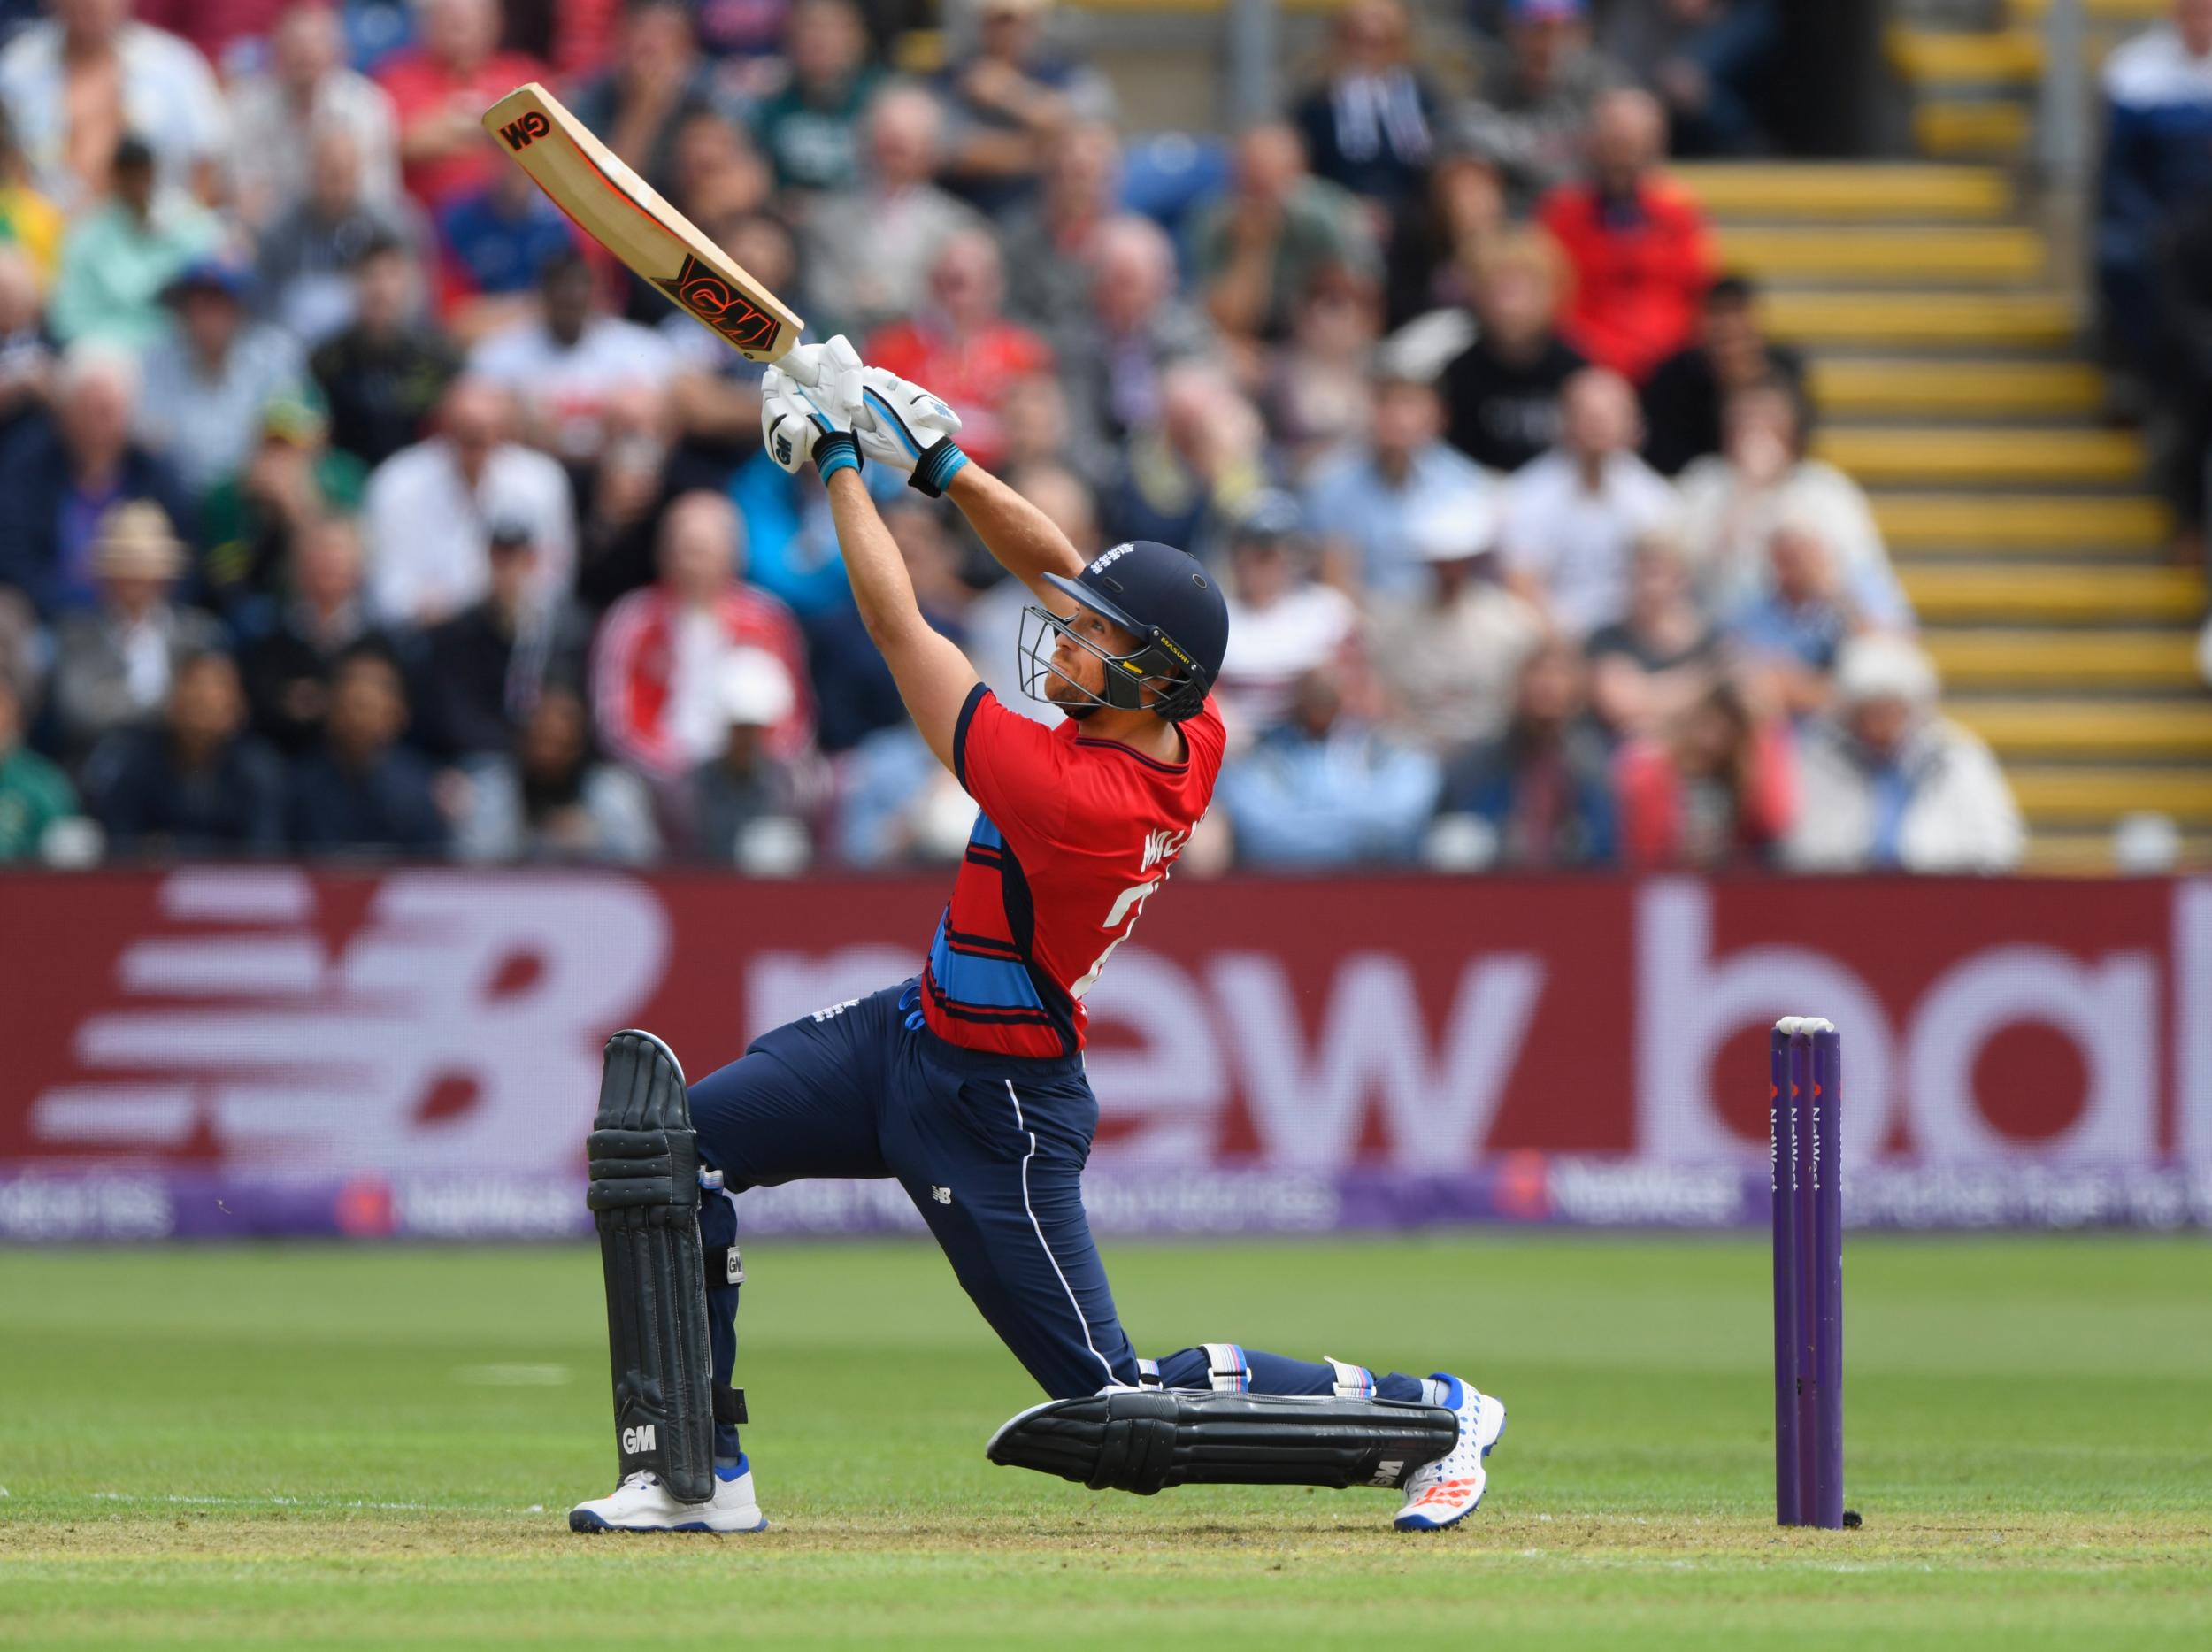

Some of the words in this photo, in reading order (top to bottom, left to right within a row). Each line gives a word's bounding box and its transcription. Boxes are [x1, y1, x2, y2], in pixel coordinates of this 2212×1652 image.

[499, 111, 550, 151] GM
[680, 277, 772, 344] GM
[776, 433, 792, 465] GM
[1160, 636, 1190, 665] MASURI
[623, 1425, 656, 1454] GM
